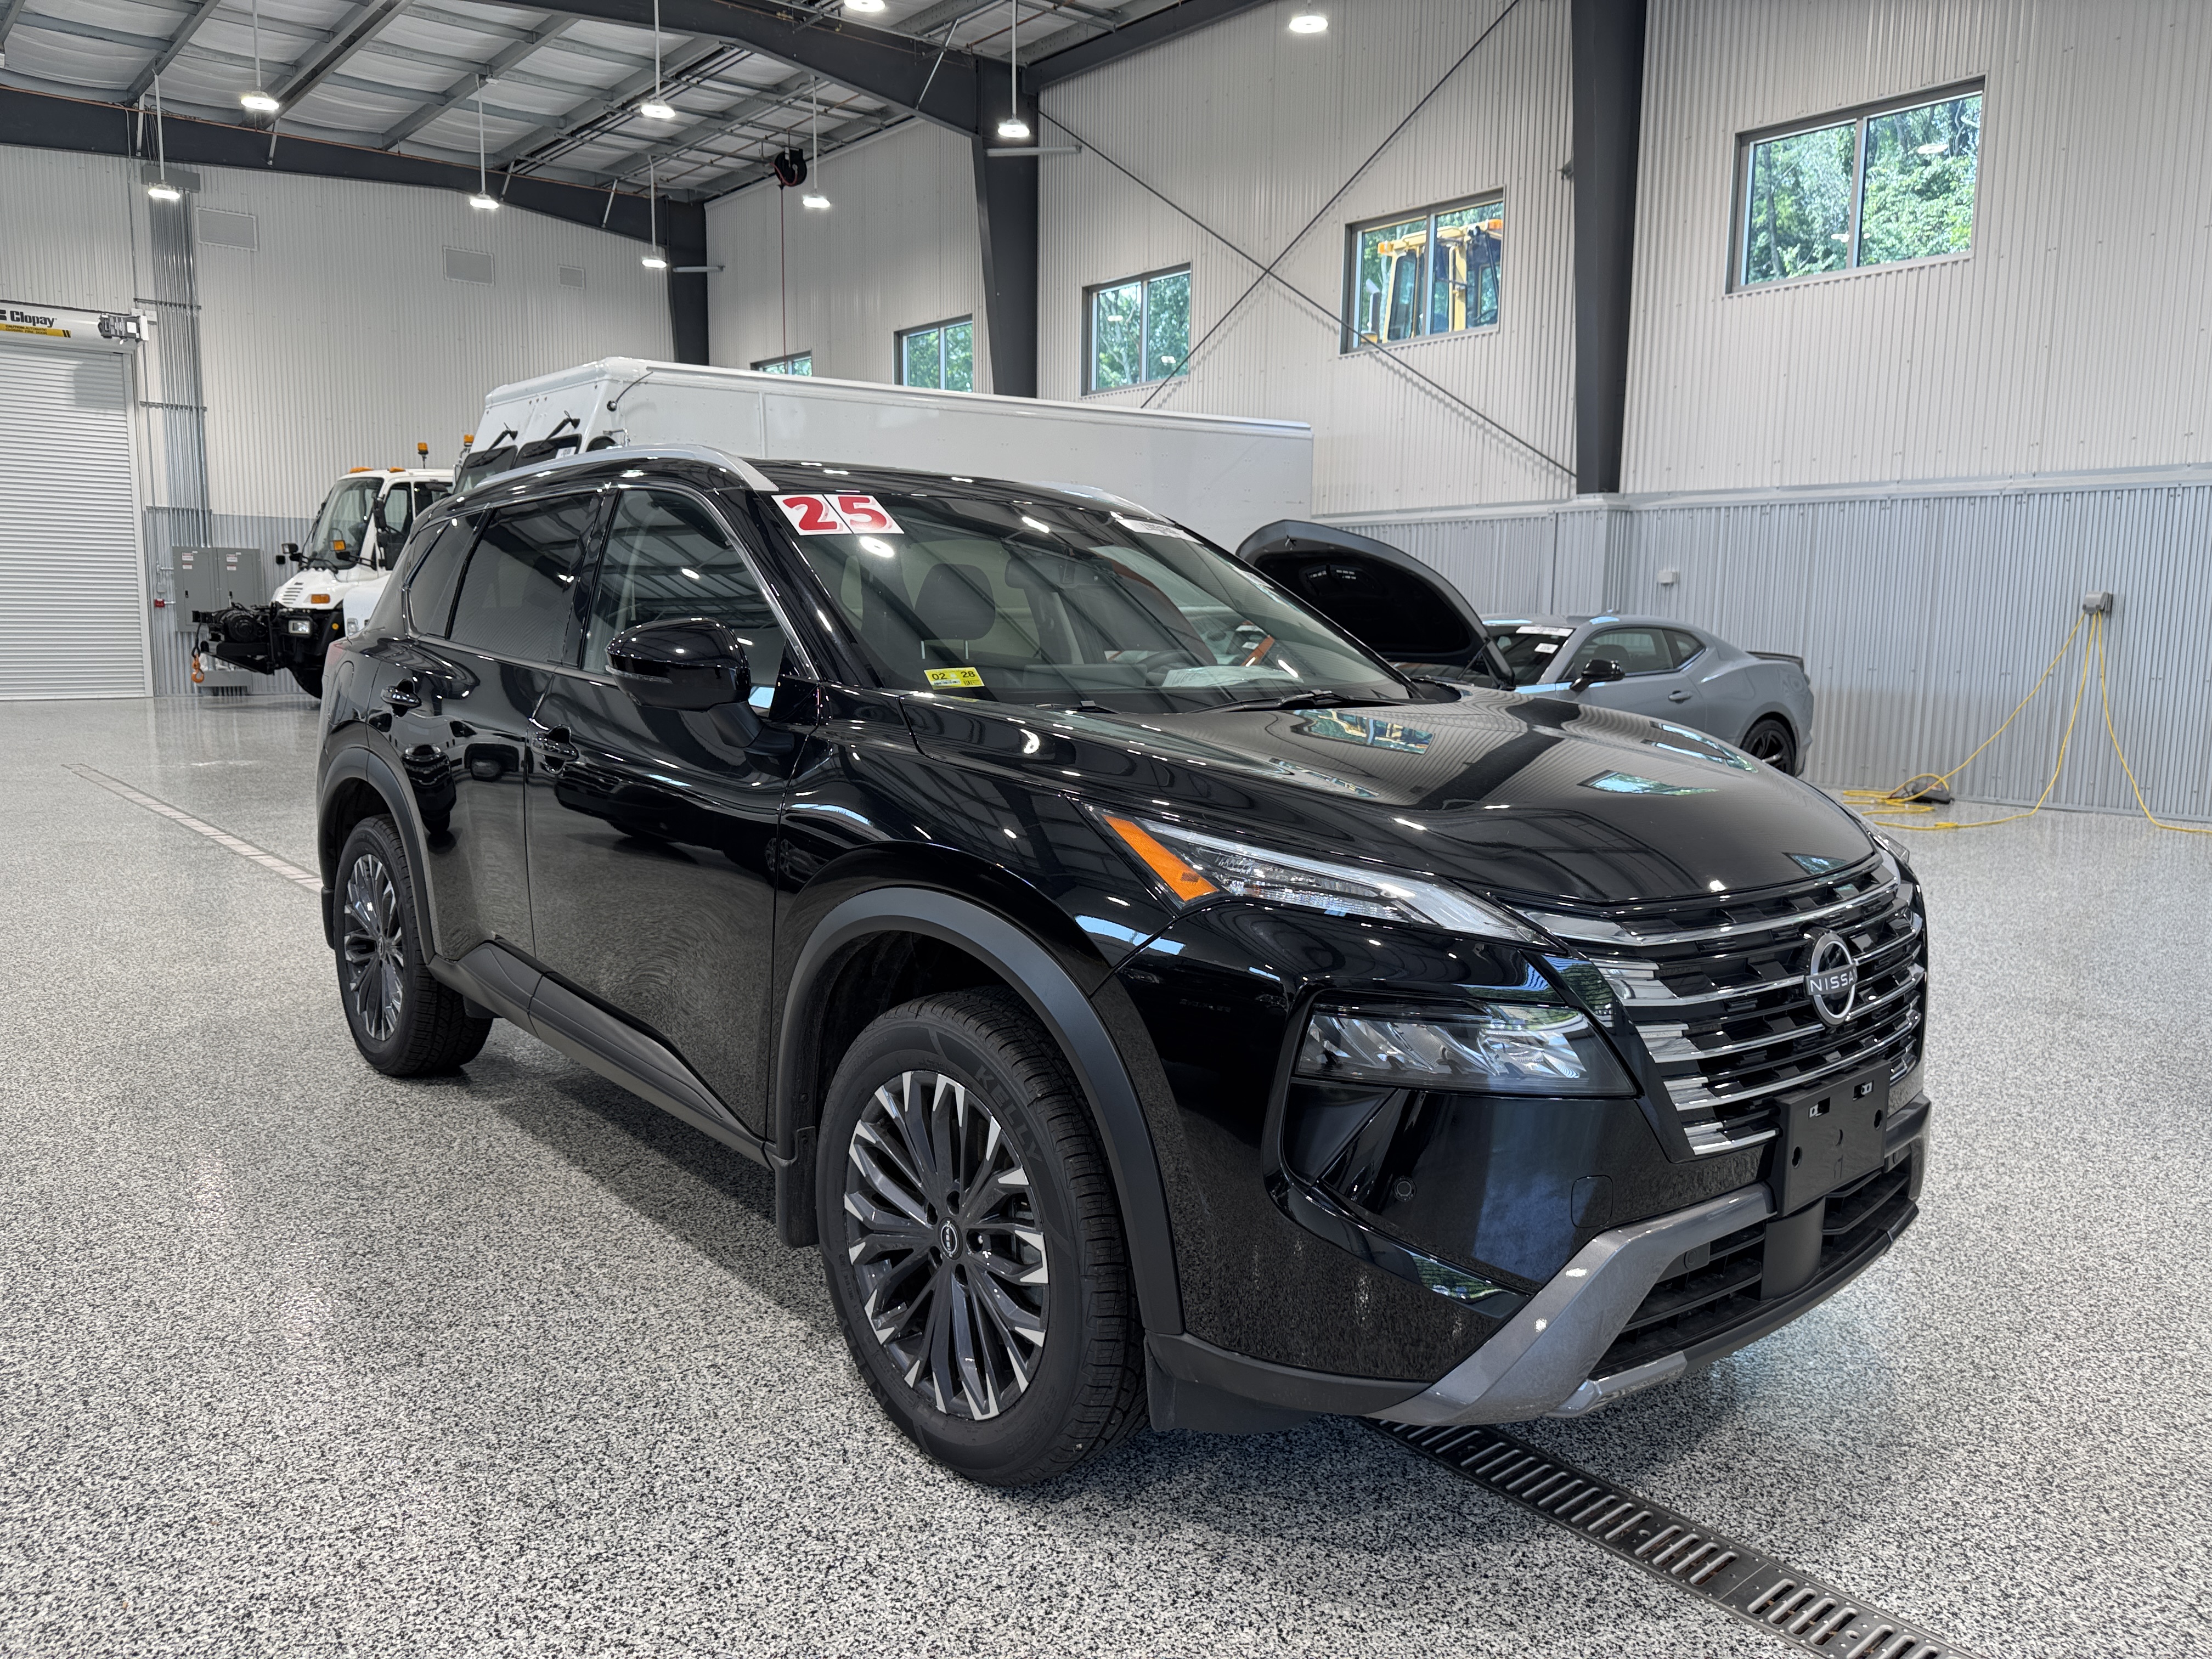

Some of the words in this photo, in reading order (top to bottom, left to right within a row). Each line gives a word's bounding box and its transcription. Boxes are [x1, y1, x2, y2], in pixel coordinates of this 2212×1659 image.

[10, 311, 54, 328] Clopay
[783, 496, 889, 531] 25
[1810, 968, 1857, 992] NISSAN
[974, 1065, 1043, 1161] KELLY
